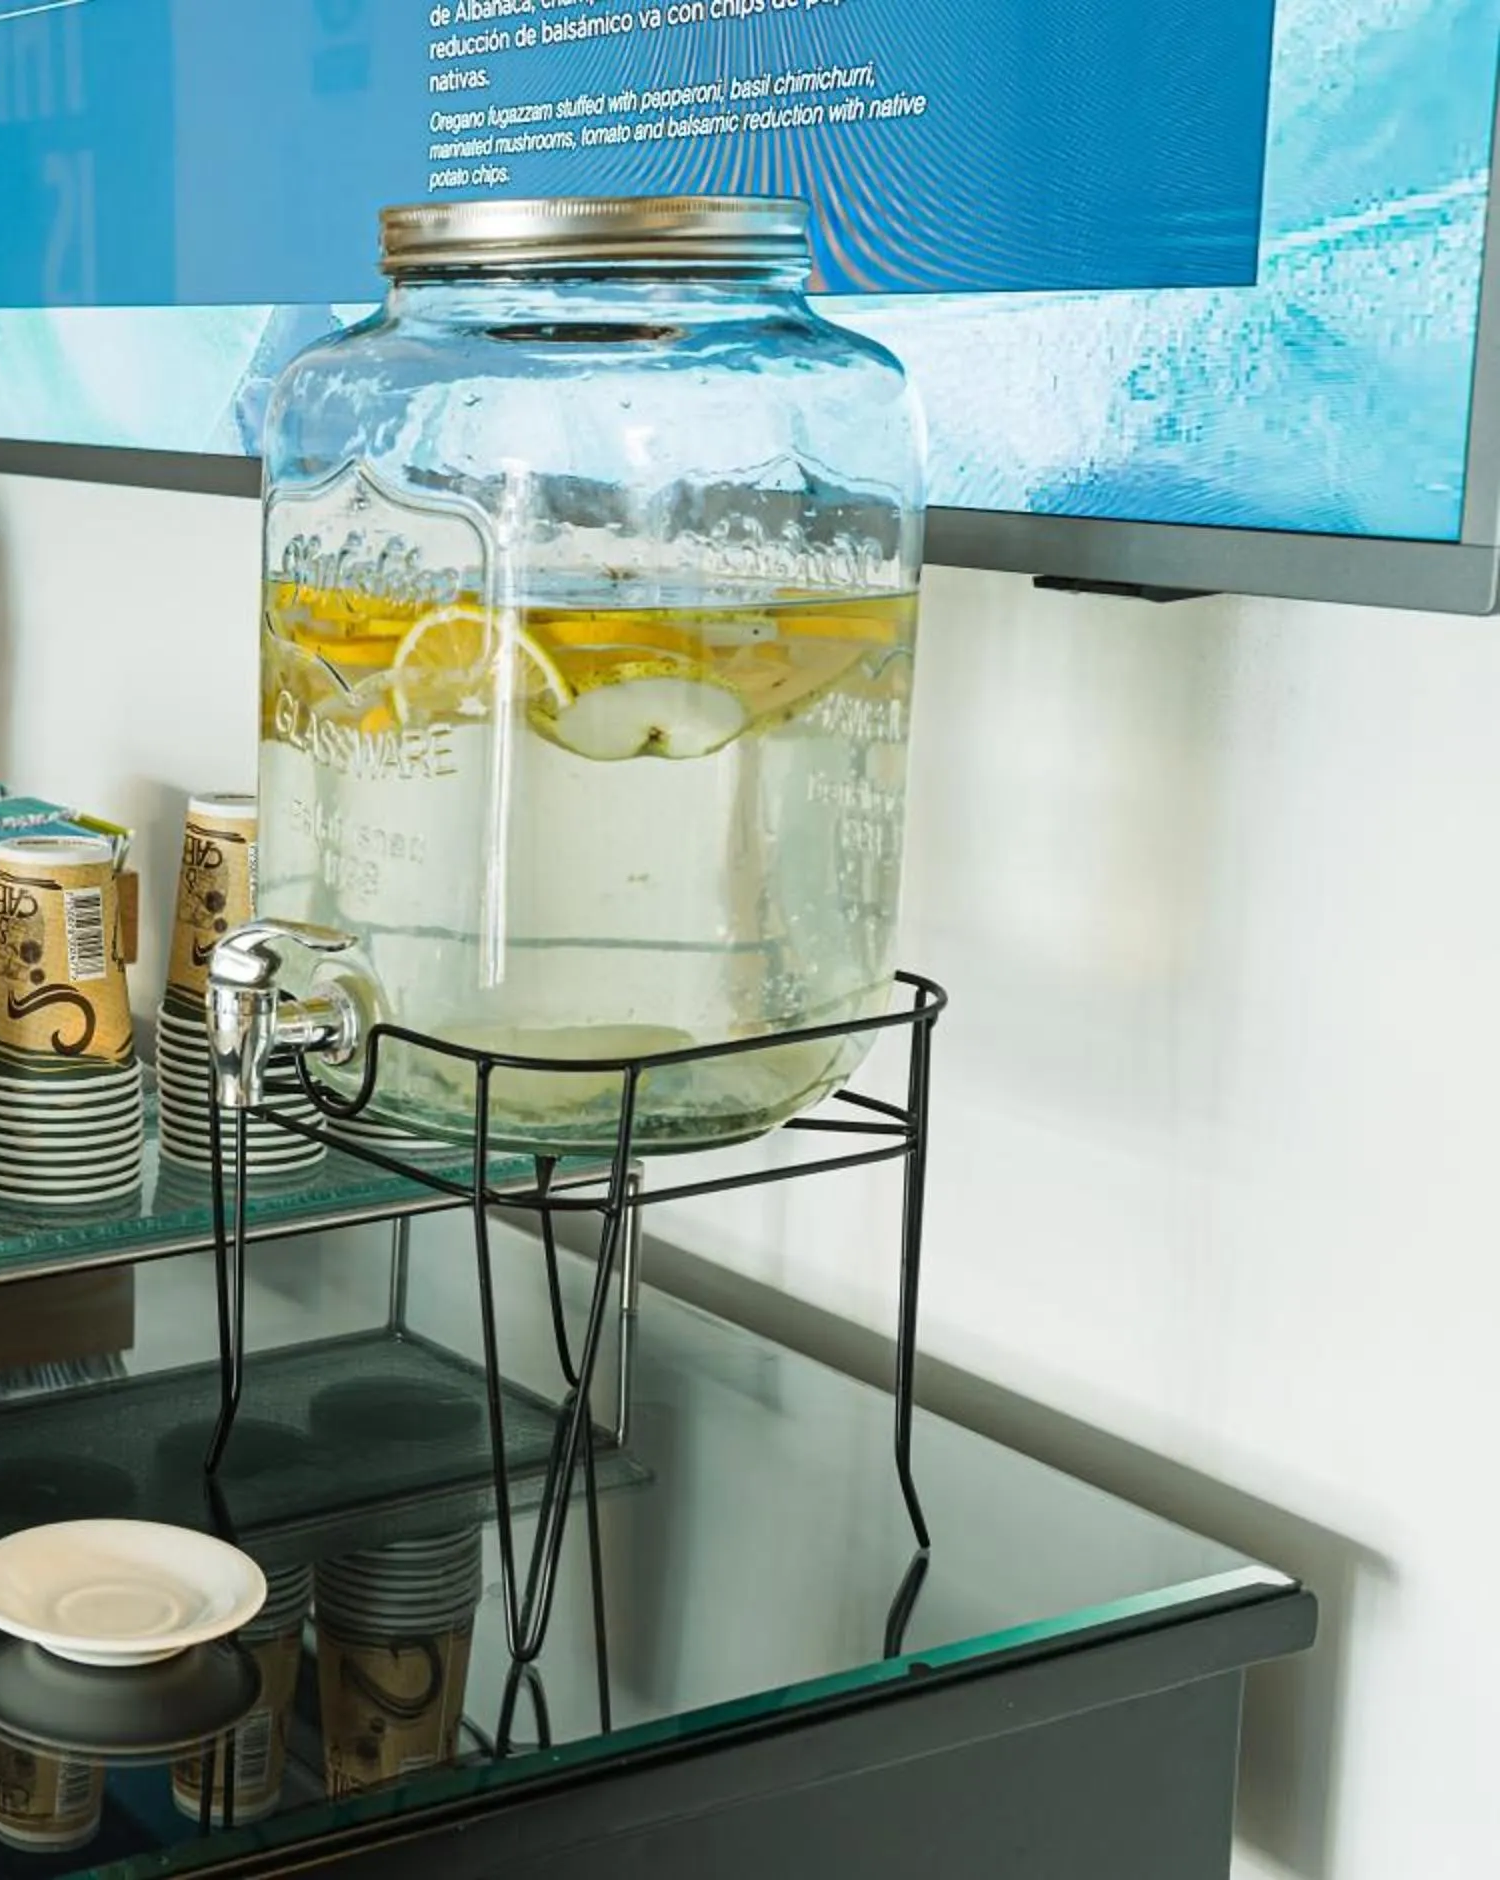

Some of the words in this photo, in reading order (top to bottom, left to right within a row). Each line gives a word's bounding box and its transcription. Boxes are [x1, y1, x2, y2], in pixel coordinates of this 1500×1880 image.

[429, 28, 510, 59] reducción
[515, 27, 537, 47] de
[542, 10, 632, 44] balsámico
[639, 8, 661, 29] va
[667, 3, 704, 24] con
[430, 7, 450, 27] de
[429, 68, 490, 93] nativas.
[430, 111, 484, 134] Oregano
[487, 102, 552, 129] fugazzam
[555, 94, 603, 119] stuffed
[608, 90, 636, 112] with
[640, 78, 724, 115] pepperoni,
[730, 72, 769, 99] basil
[773, 60, 875, 94] chimichurri,
[495, 130, 577, 154] mushrooms,
[581, 124, 630, 147] tomato
[634, 118, 664, 141] and
[667, 110, 739, 139] balsamic
[742, 102, 823, 131] reduction
[828, 97, 865, 123] with
[869, 91, 927, 119] native
[429, 168, 469, 190] potato
[472, 163, 510, 188] chips.
